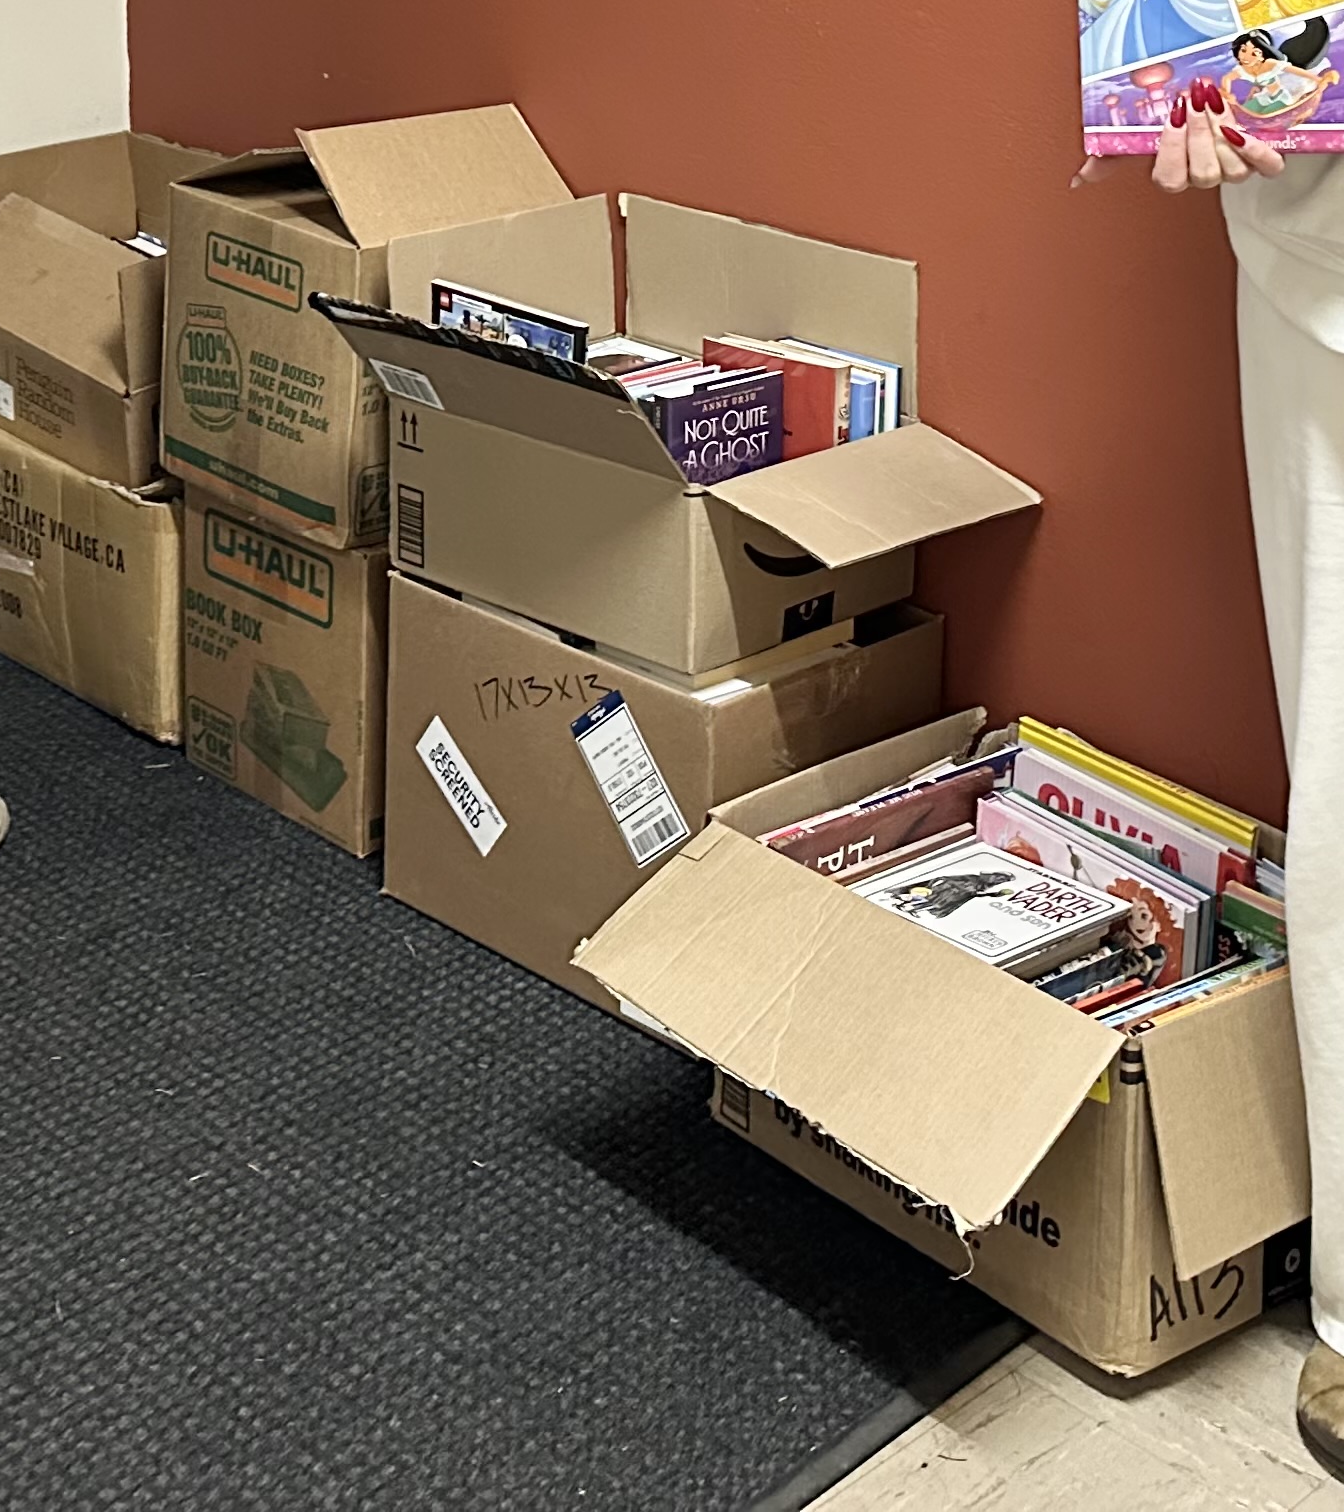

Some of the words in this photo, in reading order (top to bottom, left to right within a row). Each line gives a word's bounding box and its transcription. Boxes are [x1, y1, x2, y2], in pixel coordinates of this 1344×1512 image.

[212, 241, 297, 292] U-HAUL
[185, 331, 232, 365] 100%
[16, 356, 76, 404] Penguin
[248, 369, 276, 392] TAKE
[278, 381, 323, 411] PLENTY!
[249, 350, 279, 372] NEED
[281, 362, 325, 391] BOXES?
[17, 378, 76, 425] Random
[17, 399, 62, 439] House
[248, 390, 274, 412] We'll
[276, 400, 298, 423] Buy
[300, 410, 330, 433] Back
[702, 399, 730, 413] ANNE
[267, 417, 304, 444] Extras.
[684, 417, 720, 444] NOT
[722, 405, 769, 437] QUITE
[682, 449, 698, 471] A
[700, 431, 770, 470] GHOST
[213, 520, 325, 599] U-HAUL
[186, 588, 226, 627] BOOK
[232, 609, 263, 644] BOX
[428, 749, 480, 829] SCREENED
[435, 742, 485, 816] SECURITY
[989, 900, 1025, 917] and
[1020, 914, 1052, 930] son
[1007, 890, 1077, 923] VADER
[1026, 881, 1102, 914] DARTH
